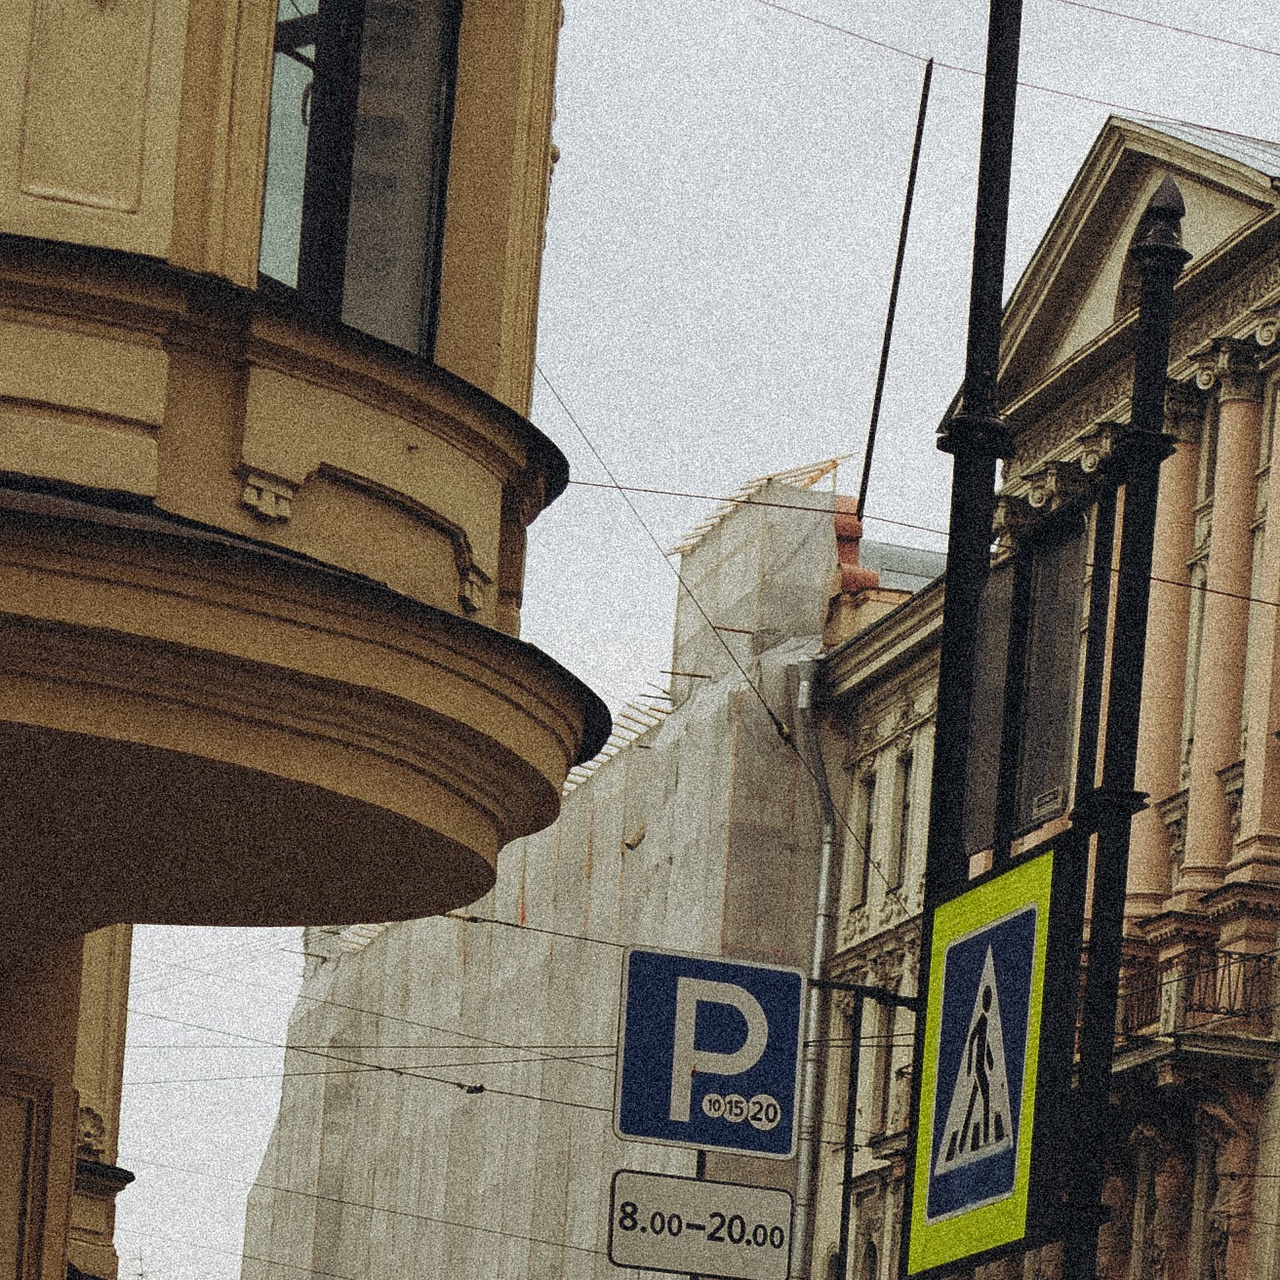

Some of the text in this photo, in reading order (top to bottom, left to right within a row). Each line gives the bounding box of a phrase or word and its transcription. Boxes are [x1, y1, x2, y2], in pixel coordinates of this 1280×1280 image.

[670, 976, 769, 1122] P
[707, 1099, 777, 1123] 10 15 20
